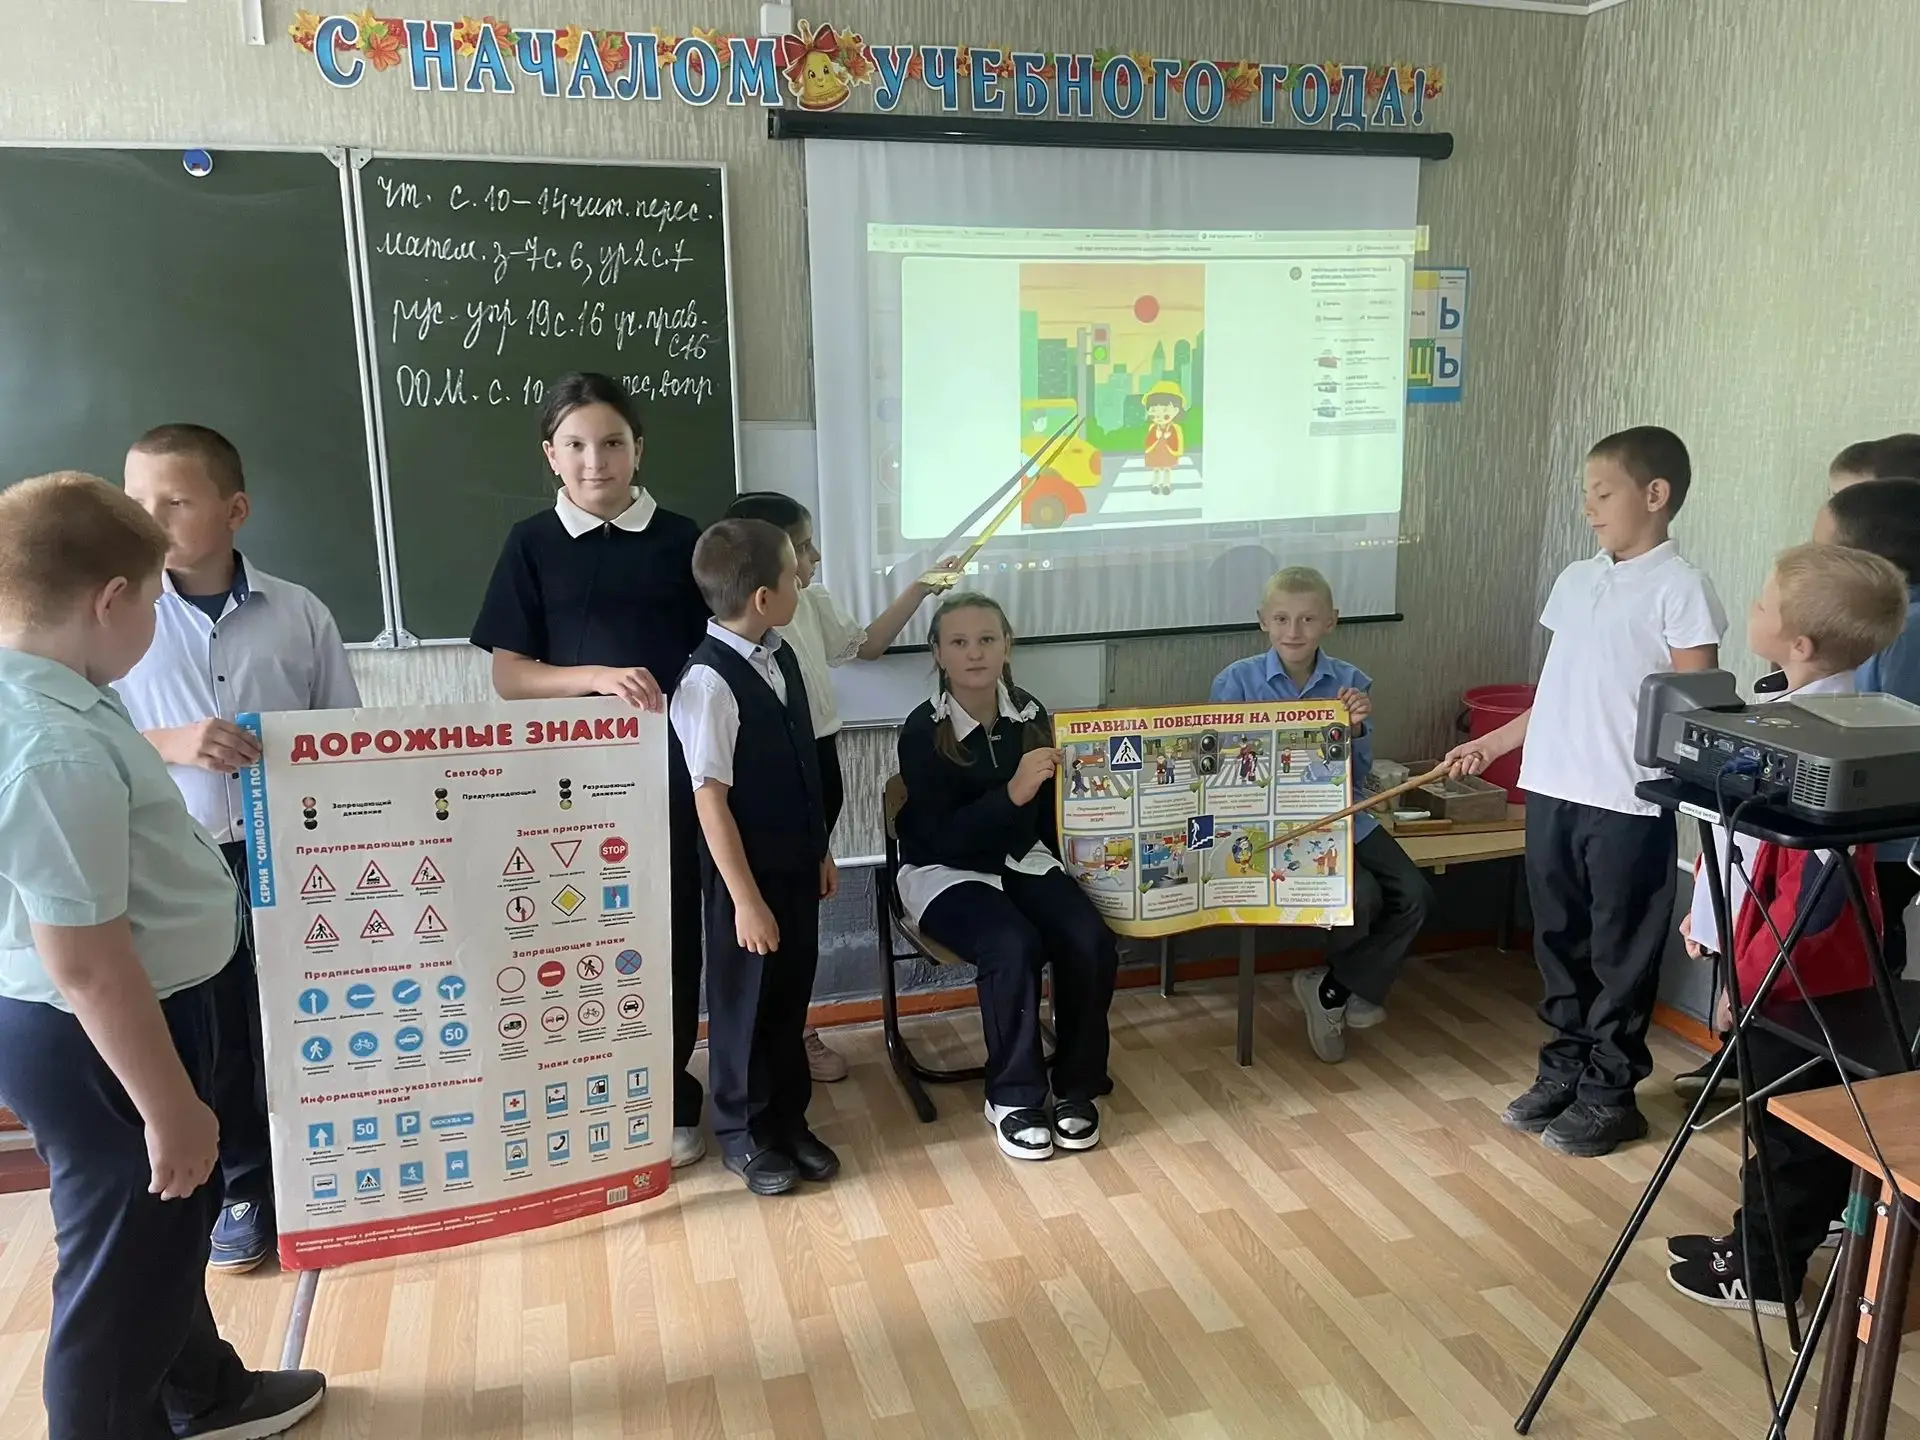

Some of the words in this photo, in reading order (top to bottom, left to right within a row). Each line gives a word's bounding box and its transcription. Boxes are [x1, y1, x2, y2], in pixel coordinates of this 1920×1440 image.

[314, 16, 364, 88] С
[404, 19, 784, 106] НАЧАЛОМ
[870, 45, 1226, 122] УЧЕБНОГО
[1259, 65, 1426, 130] ГОДА!
[1070, 718, 1148, 734] ПРАВИЛА
[1153, 713, 1244, 729] ПОВЕДЕНИЯ
[1249, 711, 1270, 723] НА
[1275, 709, 1335, 723] ДОРОГЕ
[291, 723, 512, 762] ДОРОЖНЫЕ
[526, 716, 640, 743] ЗНАКИ
[444, 767, 503, 779] Светофор
[517, 827, 549, 837] Знаки
[553, 821, 616, 834] приоритета
[296, 839, 415, 855] Предупреждающие
[419, 837, 453, 846] знаки
[602, 845, 626, 856] STOP
[260, 868, 271, 904] СЕРИЯ
[512, 941, 592, 959] Запрещающие
[595, 936, 625, 947] знаки
[304, 963, 412, 980] Предписывающие
[420, 959, 453, 969] знаки
[445, 1027, 464, 1042] 50
[537, 1060, 569, 1071] Знаки
[572, 1051, 613, 1064] сервиса
[377, 1094, 411, 1105] знаки
[356, 1122, 375, 1136] 50
